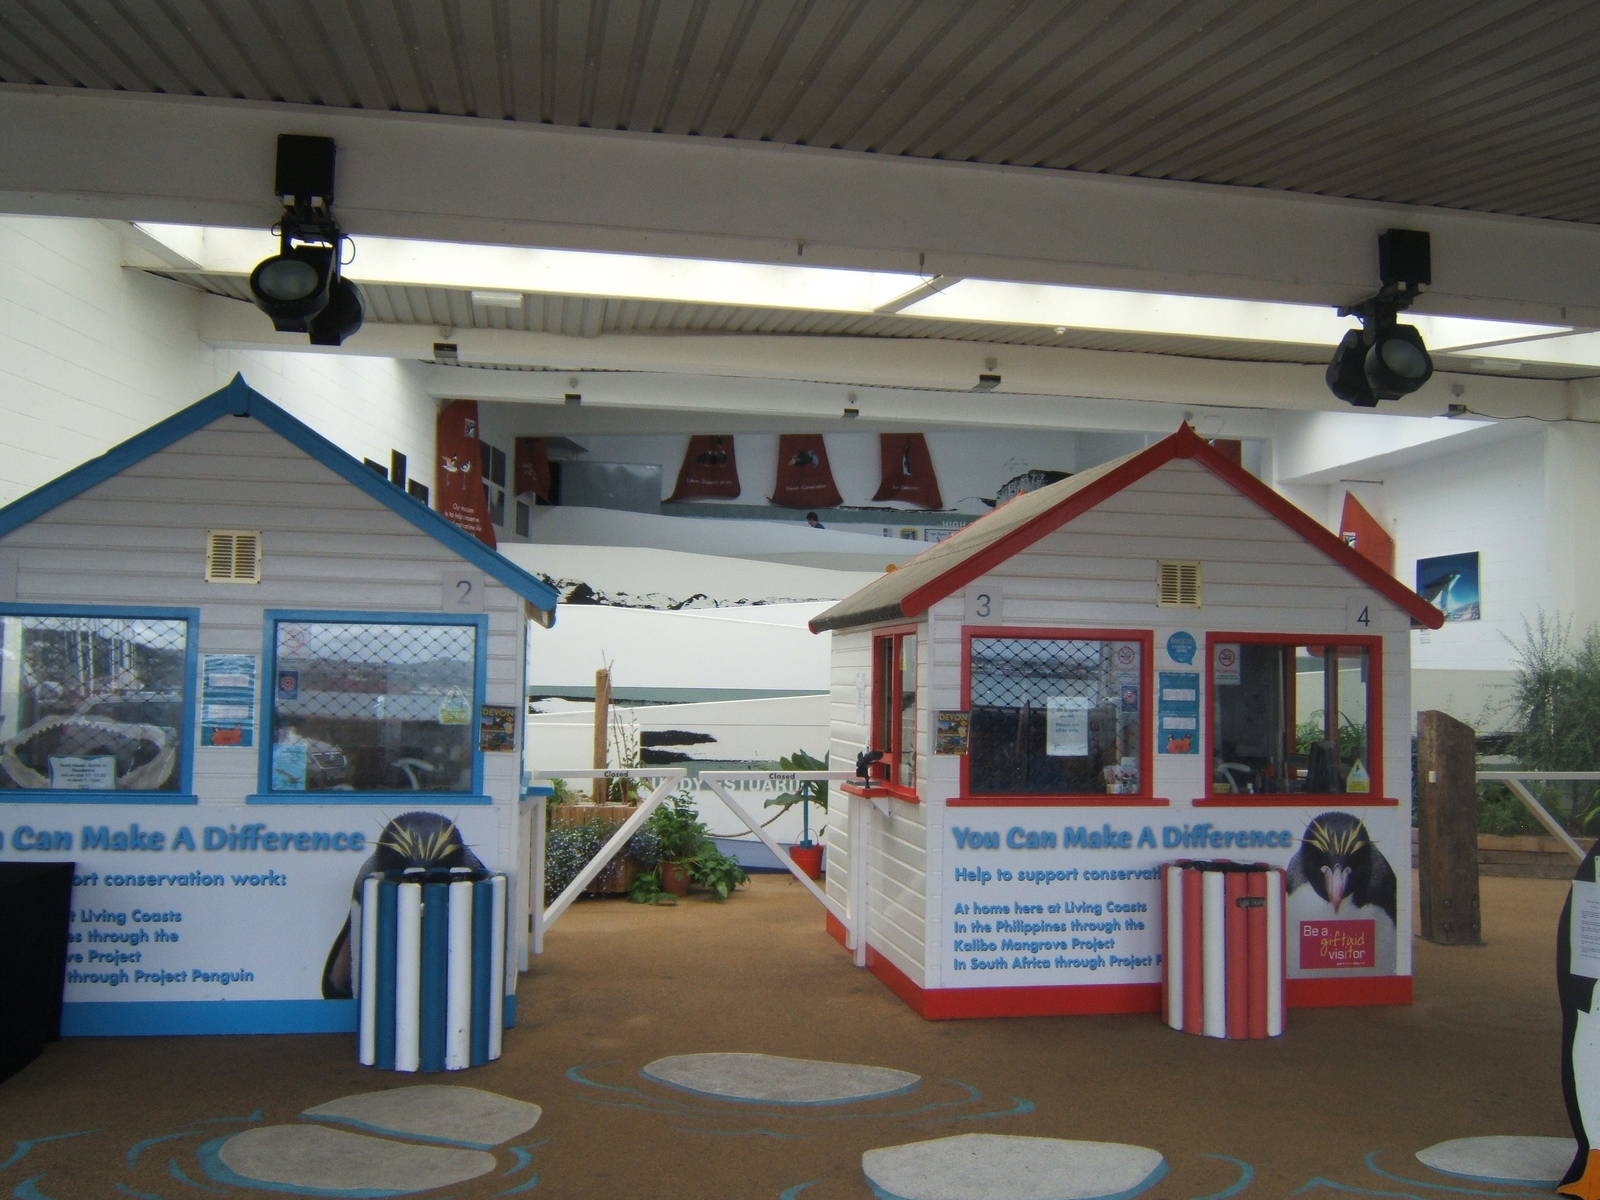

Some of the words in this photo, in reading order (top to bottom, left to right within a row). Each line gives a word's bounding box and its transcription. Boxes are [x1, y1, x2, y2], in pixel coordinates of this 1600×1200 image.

[456, 580, 472, 604] 2
[976, 594, 991, 617] 3
[1357, 605, 1370, 627] 4
[939, 713, 967, 721] DEVON
[604, 770, 629, 778] Closed
[12, 825, 73, 851] Can
[81, 823, 166, 851] Make
[172, 826, 196, 850] A
[203, 823, 366, 852] Difference
[952, 827, 999, 849] You
[1006, 827, 1056, 849] Can
[1063, 824, 1132, 849] Make
[1137, 827, 1158, 848] A
[1162, 823, 1292, 848] Difference
[103, 870, 224, 887] conservation
[231, 869, 287, 886] work:
[955, 866, 992, 884] Help
[997, 868, 1013, 881] to
[1017, 867, 1079, 884] support
[1083, 865, 1161, 881] conservati
[954, 903, 970, 915] At
[973, 902, 1010, 914] home
[1015, 902, 1044, 914] here
[1047, 904, 1061, 914] at
[1065, 901, 1102, 916] Living
[1106, 901, 1148, 913] Coasts
[80, 909, 127, 926] Living
[131, 909, 183, 923] Coasts
[954, 921, 967, 933] In
[971, 920, 993, 933] the
[996, 919, 1067, 935] Philippines
[1071, 918, 1121, 934] through
[1125, 918, 1145, 931] the
[1303, 925, 1319, 936] Be
[1321, 927, 1329, 936] a
[87, 928, 150, 946] through
[154, 928, 180, 943] the
[954, 938, 998, 952] Kalibo
[1001, 938, 1068, 953] Mangrove
[1072, 937, 1116, 952] Project
[88, 949, 142, 966] Project
[954, 958, 967, 970] In
[970, 957, 1008, 970] South
[1012, 955, 1051, 969] Africa
[1055, 954, 1106, 970] through
[1109, 953, 1152, 969] Project
[1328, 946, 1366, 960] visitor
[67, 969, 130, 986] through
[134, 969, 188, 986] Project
[192, 967, 254, 985] Penguin
